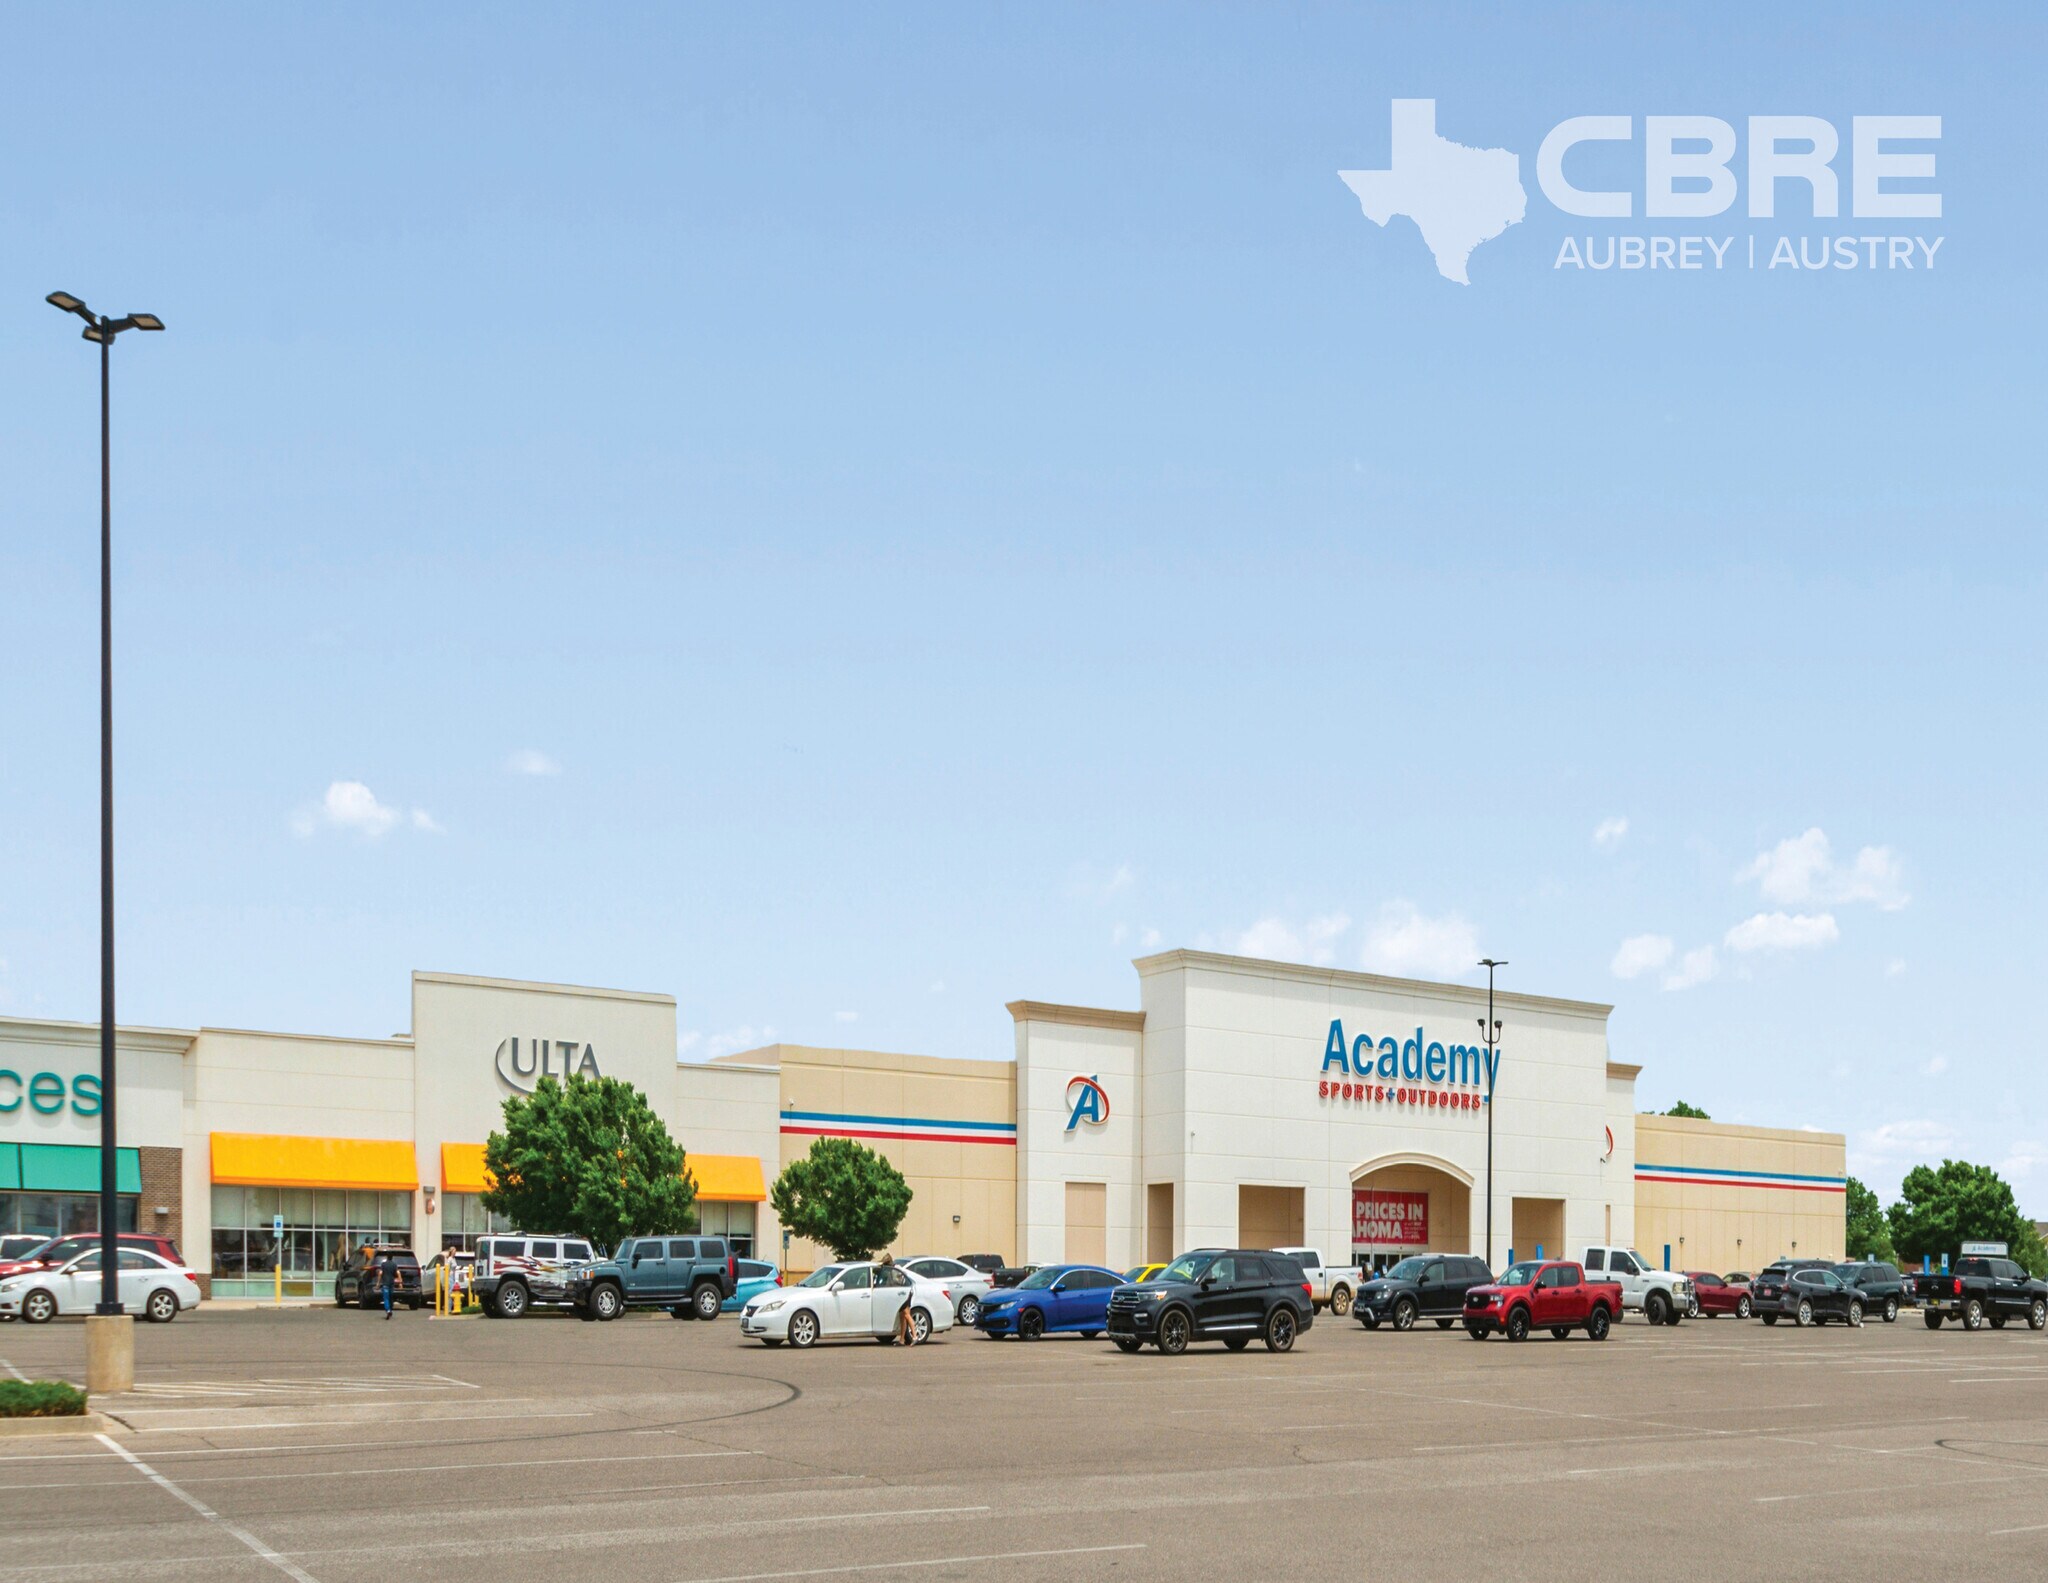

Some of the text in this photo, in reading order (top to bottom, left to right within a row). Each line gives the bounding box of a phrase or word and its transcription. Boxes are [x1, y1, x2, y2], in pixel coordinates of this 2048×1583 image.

[511, 1037, 602, 1088] ULTA
[1321, 1018, 1501, 1104] Academy
[0, 1069, 103, 1116] ces
[1356, 1201, 1424, 1221] PRICES IN
